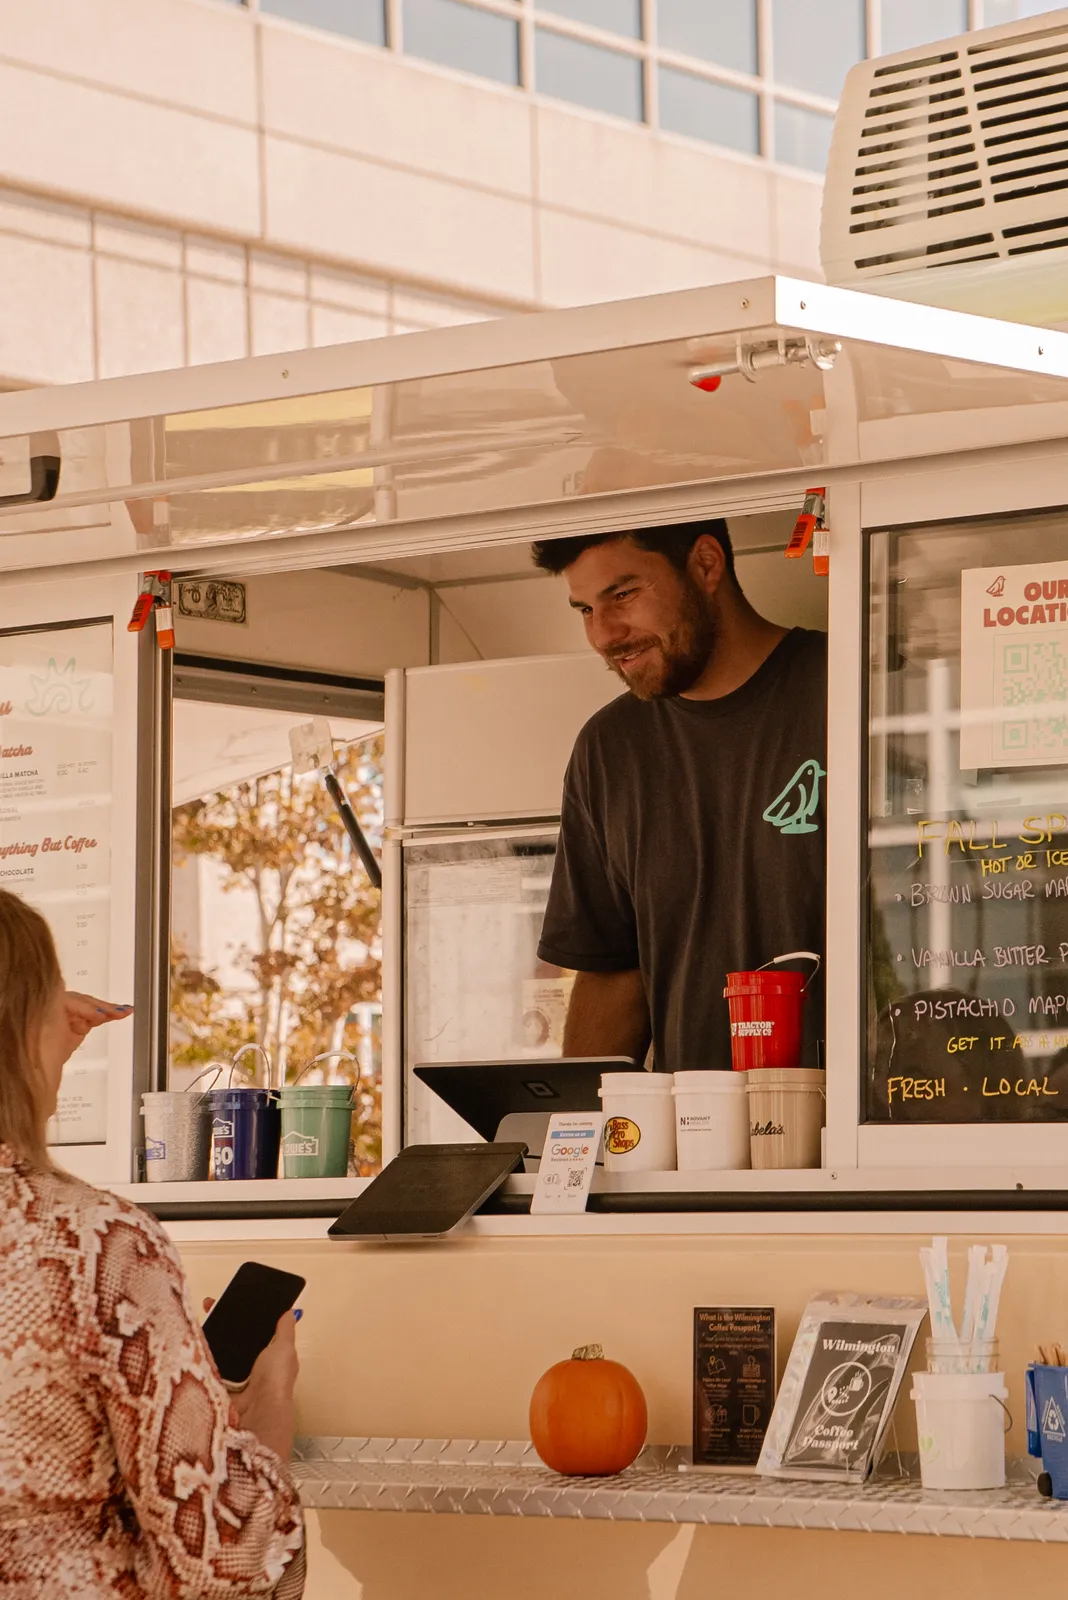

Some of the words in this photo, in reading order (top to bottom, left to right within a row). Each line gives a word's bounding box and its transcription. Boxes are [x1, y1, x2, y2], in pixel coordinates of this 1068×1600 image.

[1024, 579, 1068, 602] OUR
[984, 602, 1068, 627] LOCATI
[0, 743, 33, 759] atcha
[15, 769, 39, 778] MATCHA
[41, 837, 61, 852] But
[64, 834, 98, 854] Coffee
[918, 820, 1006, 857] FALL
[981, 855, 1013, 876] HOT
[981, 880, 1036, 903] SUGAR
[911, 947, 987, 969] VANILLA
[993, 944, 1049, 968] BUTTER
[914, 997, 1015, 1021] PISTACHIO
[1029, 995, 1068, 1016] MAP
[737, 1021, 773, 1030] TRACTOR
[737, 1029, 762, 1037] SUPPLY
[946, 1036, 980, 1054] GET
[990, 1037, 1006, 1051] IT
[887, 1076, 946, 1104] FRESH
[982, 1077, 1059, 1097] LOCAL
[612, 1118, 629, 1130] Bass
[611, 1129, 625, 1140] Pro
[283, 1141, 312, 1154] OWE'S
[551, 1143, 589, 1157] Google
[612, 1138, 635, 1150] Shops
[699, 1313, 717, 1321] What
[723, 1313, 734, 1321] the
[734, 1312, 771, 1323] Wilmington
[708, 1322, 729, 1332] Coffee
[730, 1322, 761, 1334] Passport?
[822, 1338, 896, 1356] Wilmington
[814, 1424, 853, 1439] Coffee
[801, 1435, 860, 1453] Passport
